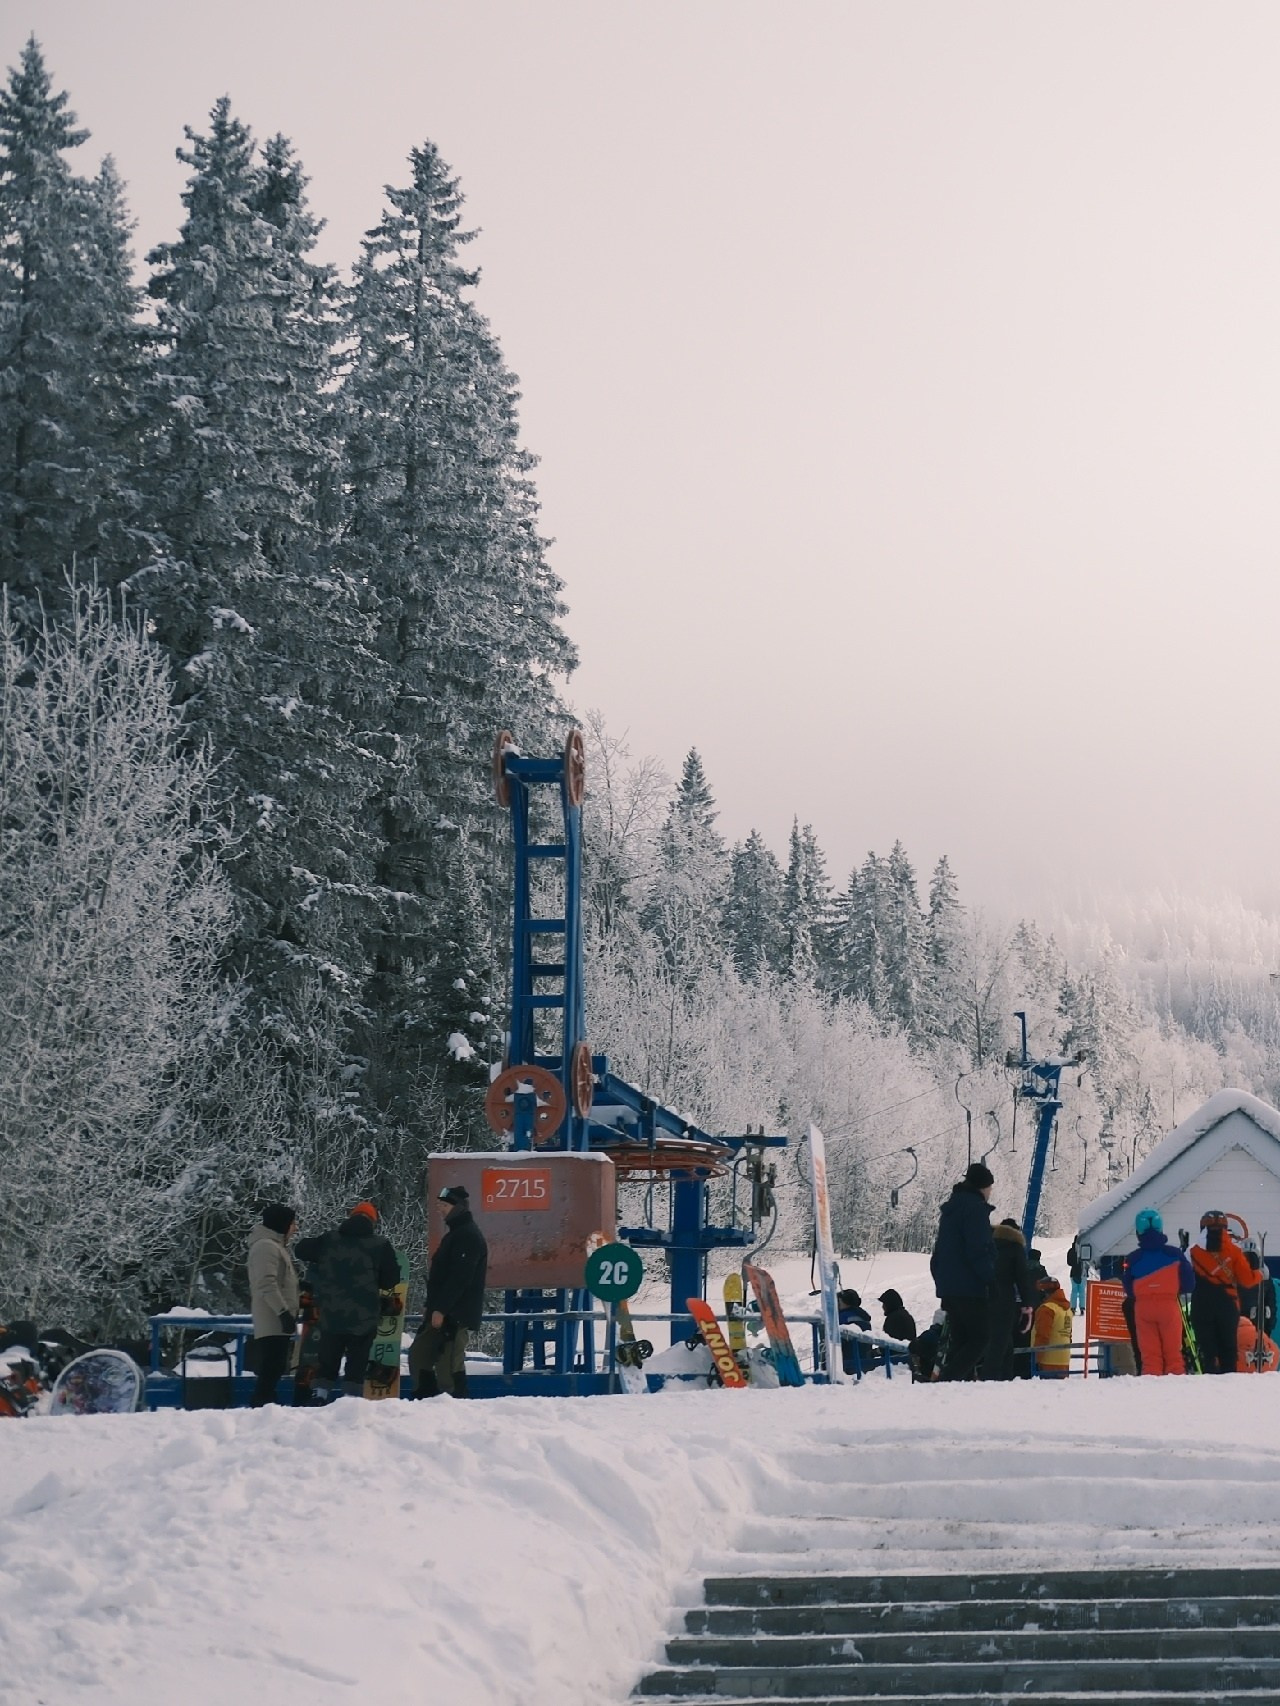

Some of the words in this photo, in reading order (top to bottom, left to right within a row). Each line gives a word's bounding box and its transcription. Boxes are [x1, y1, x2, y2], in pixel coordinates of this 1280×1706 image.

[495, 1179, 546, 1198] 2715
[598, 1261, 628, 1285] 2C
[700, 1320, 739, 1382] JOINT
